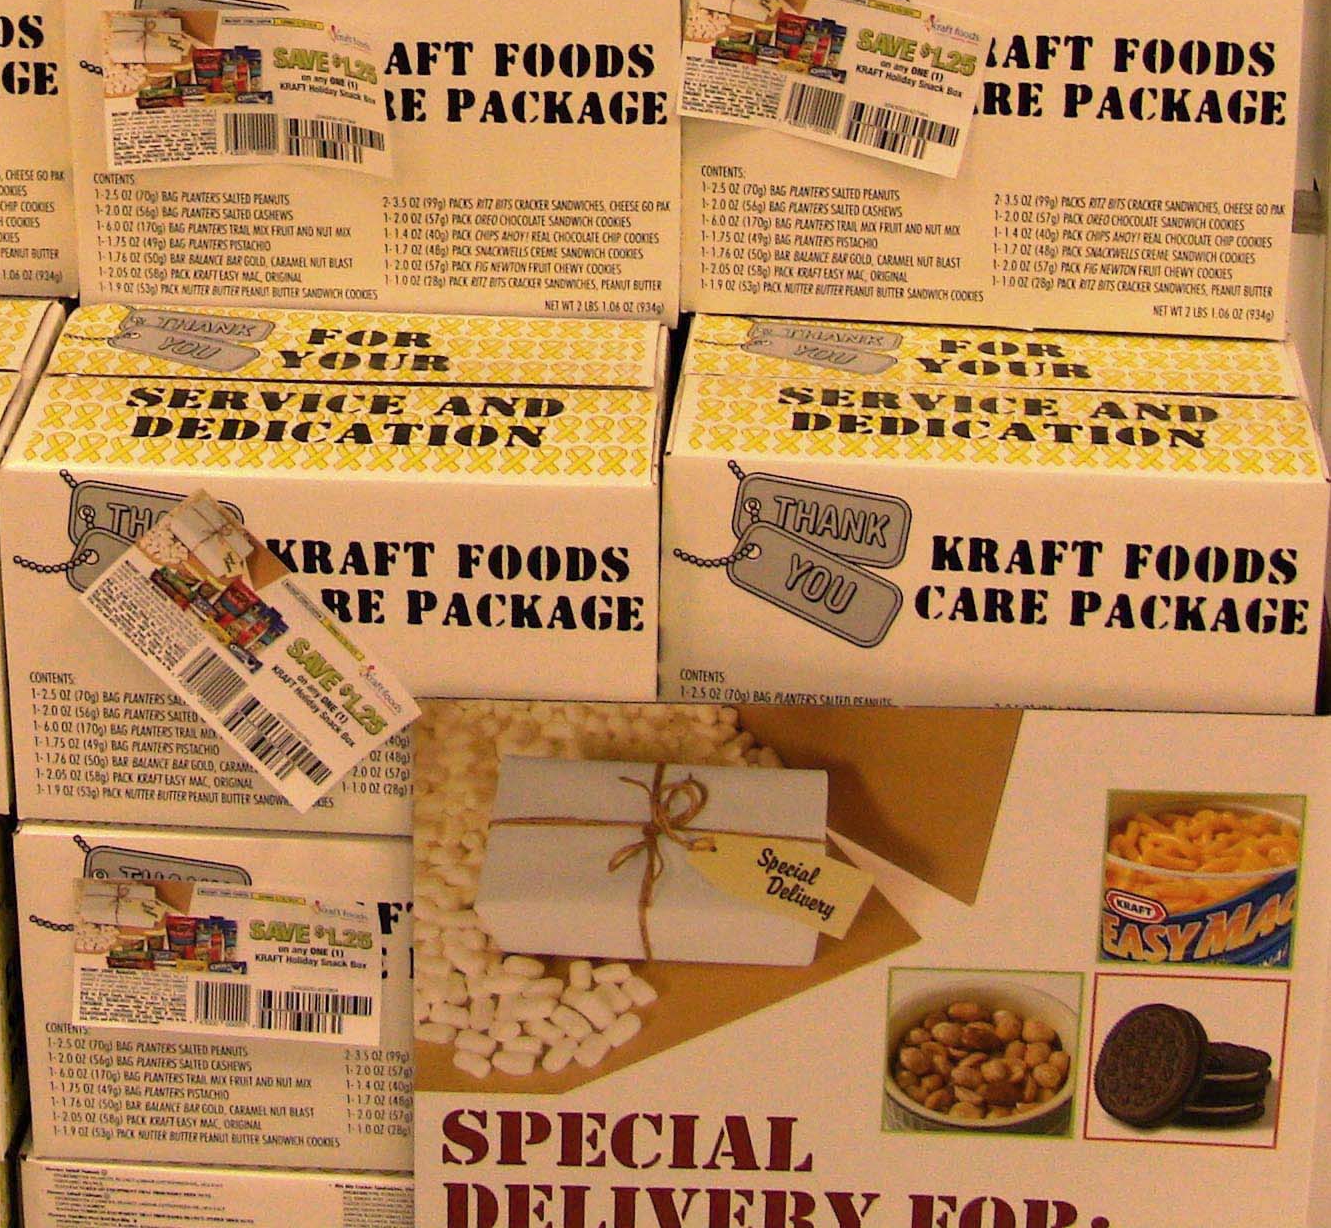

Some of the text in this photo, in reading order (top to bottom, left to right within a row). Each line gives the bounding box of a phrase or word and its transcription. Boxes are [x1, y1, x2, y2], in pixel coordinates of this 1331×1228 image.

[856, 28, 977, 77] SAVE $1.25
[881, 60, 944, 82] on any ONE (1)
[1114, 36, 1276, 77] FOODS
[856, 64, 962, 98] KRAFT Holiday Snack Box
[1064, 83, 1288, 126] PACKAGE
[701, 165, 745, 179] CONTENTS:
[1153, 305, 1167, 317] NET
[1170, 306, 1182, 317] WT
[1194, 307, 1207, 318] LBS
[1232, 308, 1243, 320] OZ
[918, 358, 1092, 379] YOUR
[938, 339, 1068, 358] FOR
[777, 386, 1221, 424] SERVICE AND
[791, 411, 1207, 448] DEDICATION
[773, 494, 892, 548] THANK
[458, 543, 631, 583] FOODS
[932, 535, 1299, 585] KRAFT FOODS
[786, 554, 858, 615] YOU
[407, 590, 645, 632] PACKAGE
[914, 585, 1311, 636] CARE PACKAGE
[755, 848, 822, 888] Special
[765, 874, 836, 922] Delivery
[1116, 897, 1153, 917] KRAFT
[1104, 913, 1199, 963] EASY
[441, 1108, 815, 1173] SPECIAL
[442, 1181, 881, 1228] DELIVERY
[908, 1194, 1111, 1228] FOR
